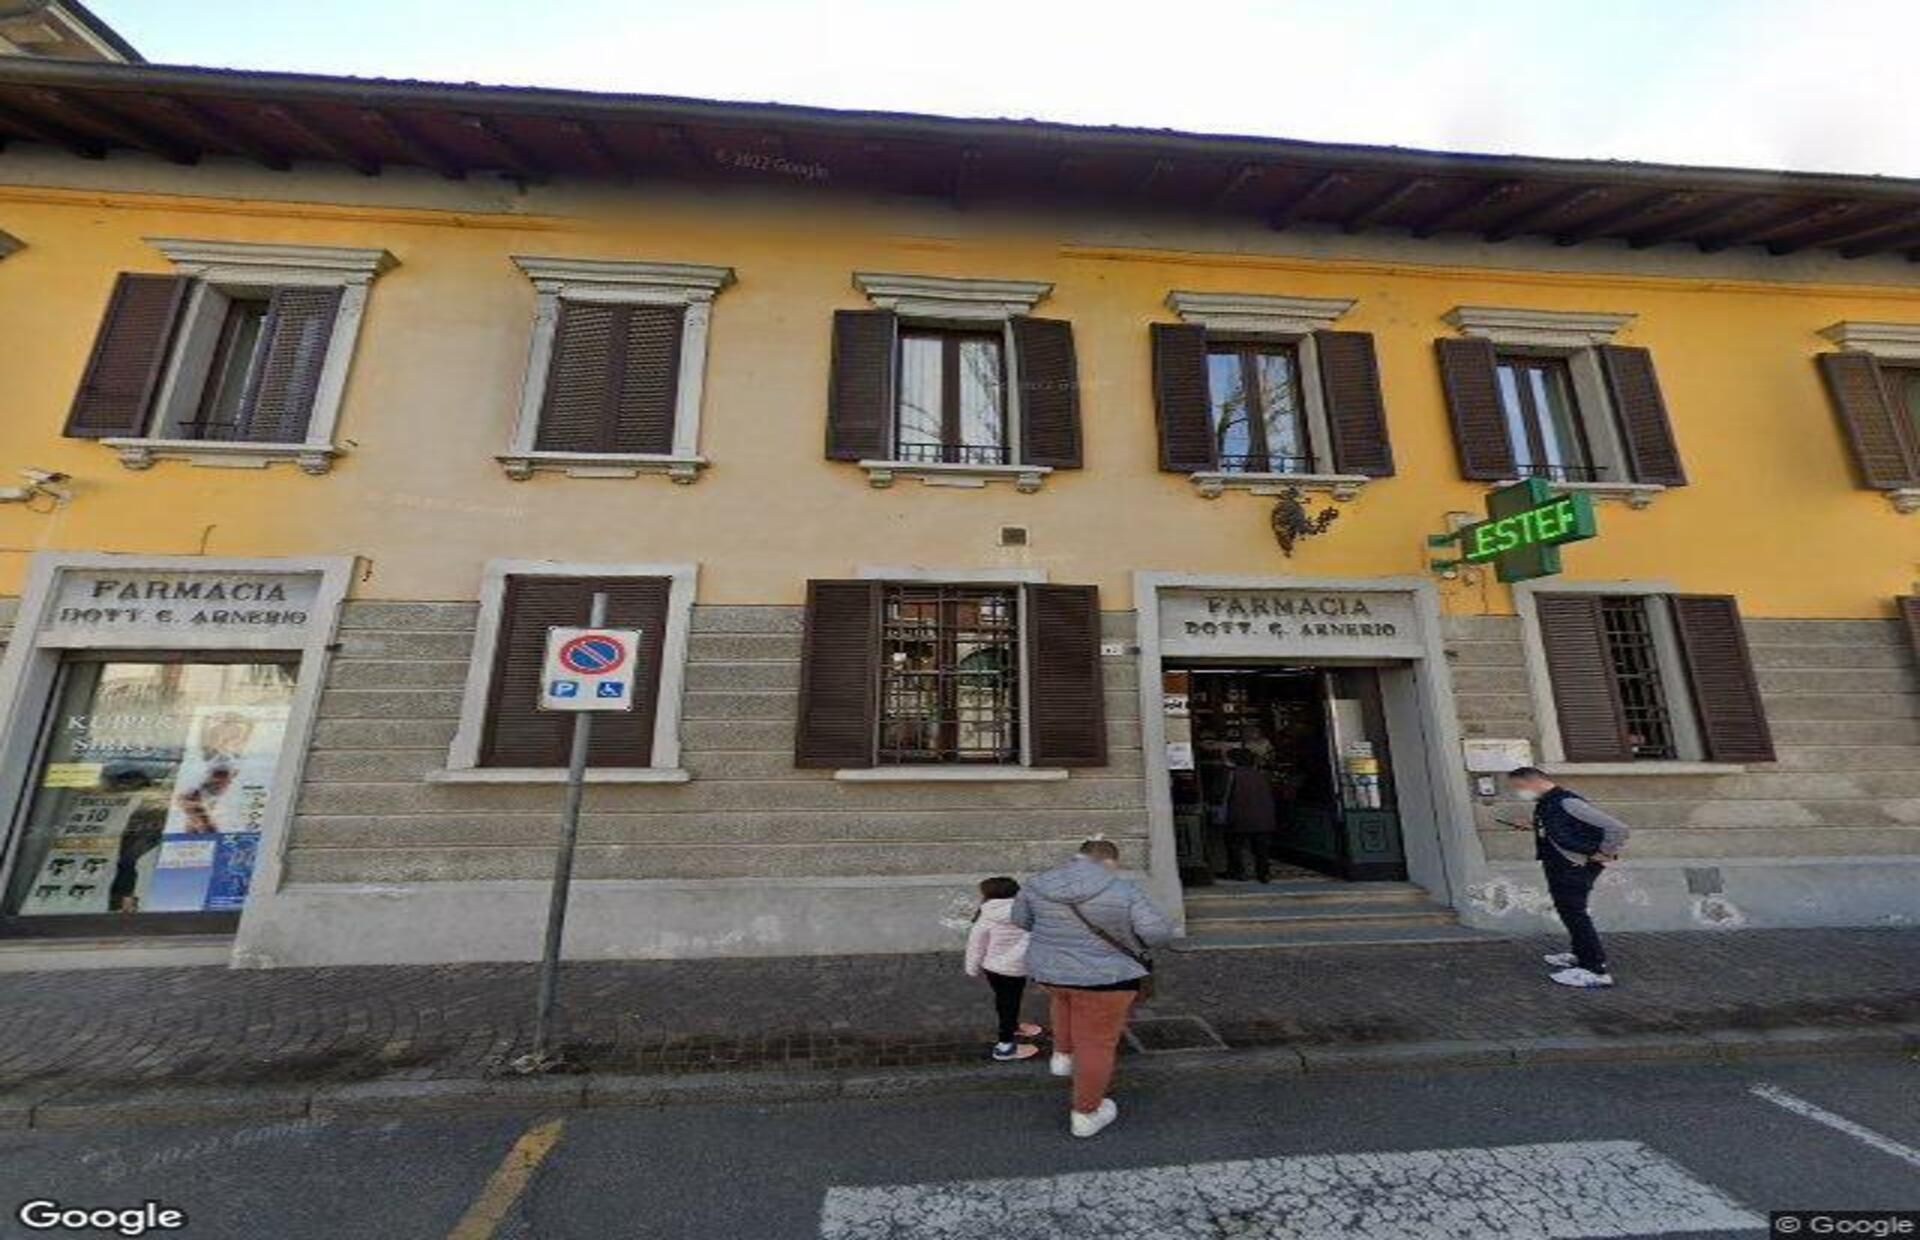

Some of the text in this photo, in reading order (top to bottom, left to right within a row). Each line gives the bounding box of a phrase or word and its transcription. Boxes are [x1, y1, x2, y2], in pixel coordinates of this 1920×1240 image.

[92, 581, 287, 601] FARMACIA
[1207, 597, 1372, 616] FARMACIA
[189, 609, 307, 625] ARNERIO
[1299, 623, 1396, 637] ARNERIO
